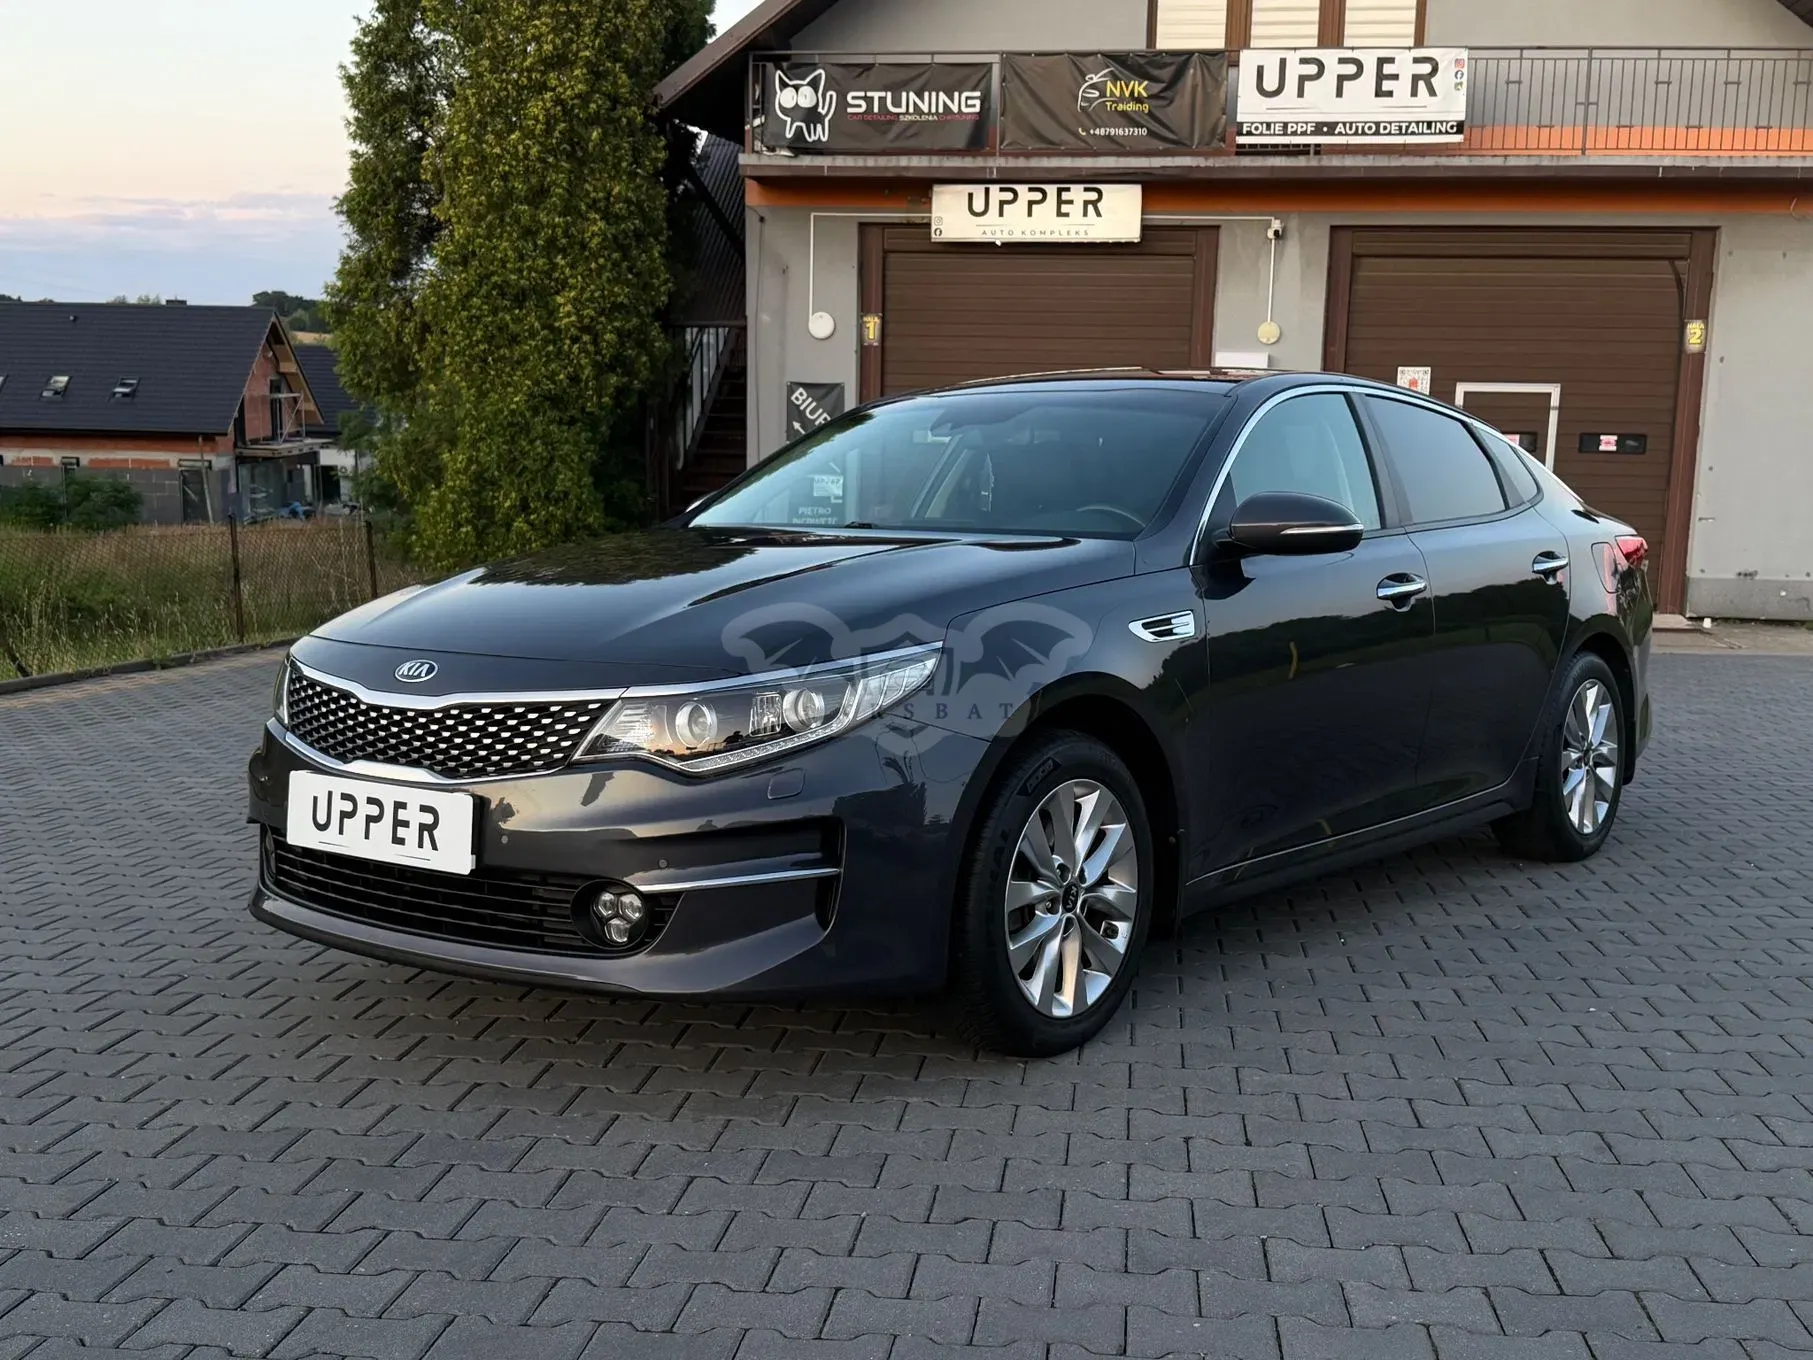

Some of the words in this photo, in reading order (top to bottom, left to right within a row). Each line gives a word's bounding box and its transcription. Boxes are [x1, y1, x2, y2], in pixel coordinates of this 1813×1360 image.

[1255, 57, 1439, 98] UPPER
[1106, 80, 1149, 98] NVK
[846, 90, 982, 114] STUNING
[1106, 101, 1149, 113] Traiding
[1242, 123, 1284, 135] FOLIE
[1287, 122, 1316, 135] PPF
[1334, 122, 1376, 135] AUTO
[1379, 121, 1457, 134] DETAILING
[967, 186, 1104, 218] UPPER
[1688, 329, 1703, 344] 2
[398, 662, 430, 677] KIA
[312, 790, 440, 851] UPPER
